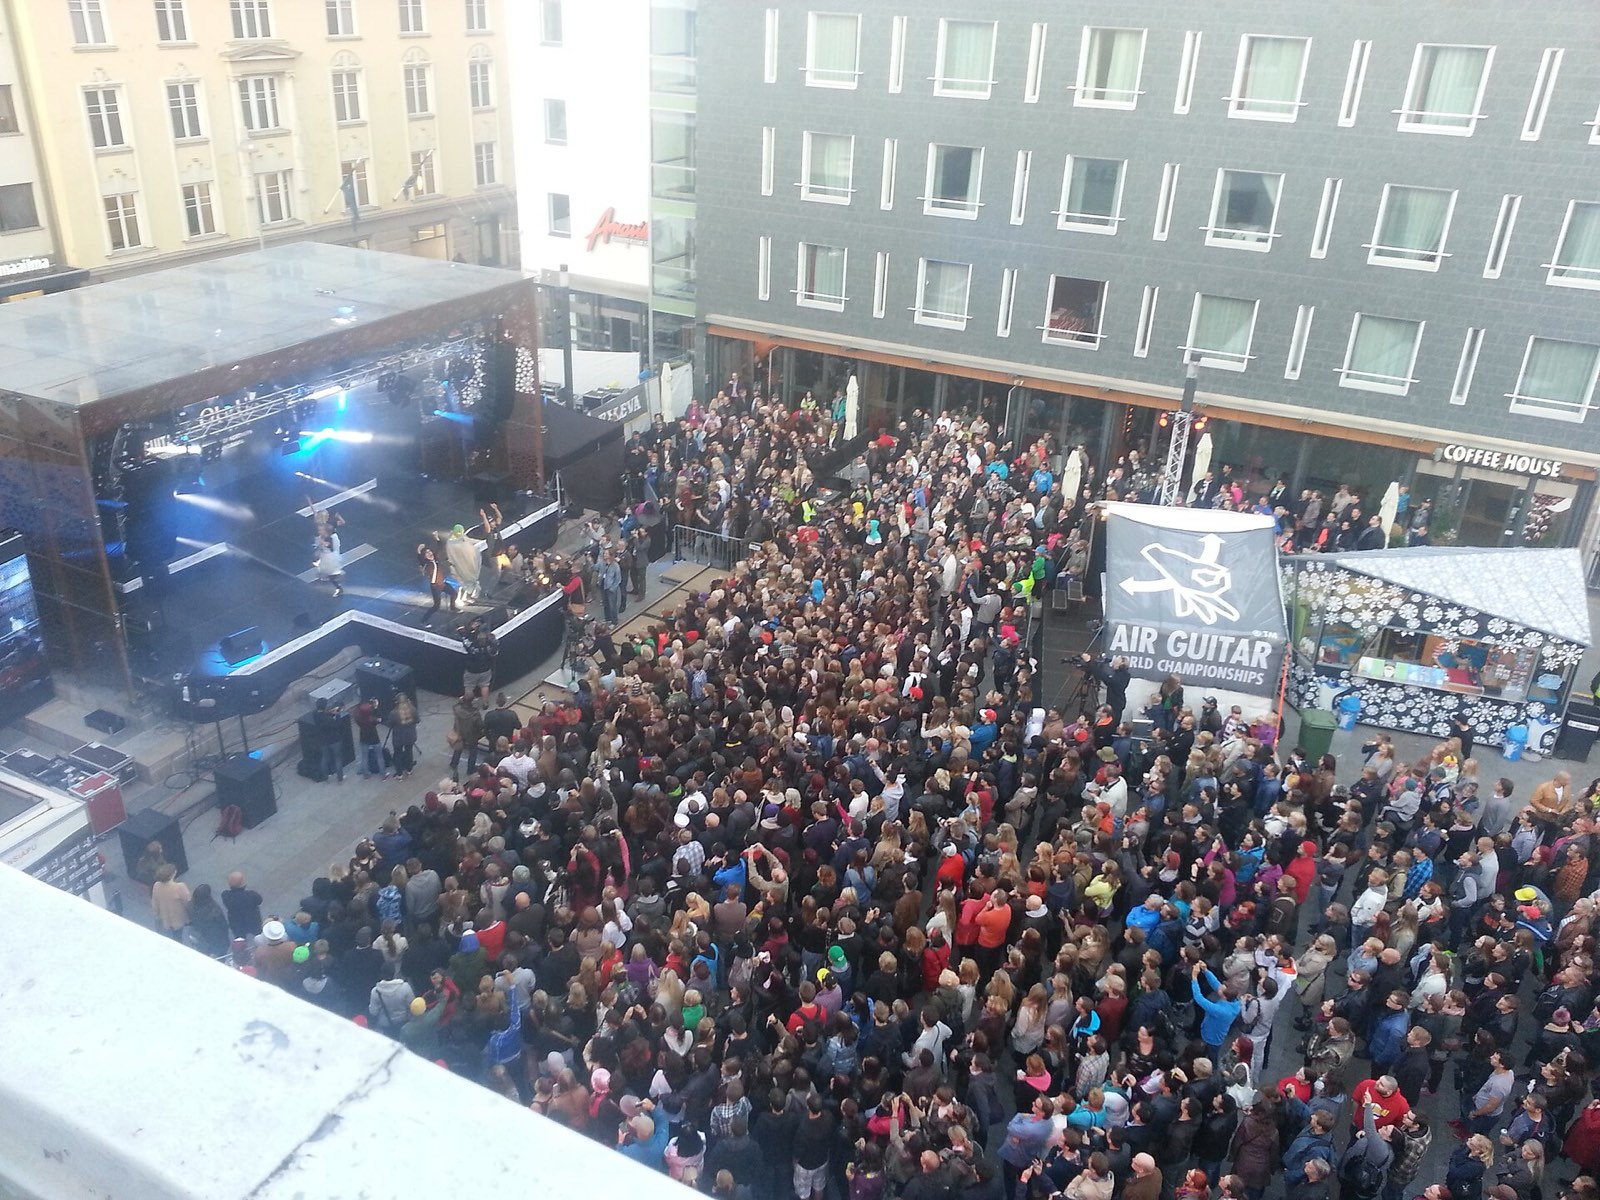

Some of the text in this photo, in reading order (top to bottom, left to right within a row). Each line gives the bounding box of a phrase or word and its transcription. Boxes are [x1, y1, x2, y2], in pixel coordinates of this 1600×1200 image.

[1444, 444, 1562, 477] COFFEE HOUSE
[1110, 624, 1273, 669] AIR GUITAR
[1157, 659, 1264, 685] CHAMPIONSHIPS
